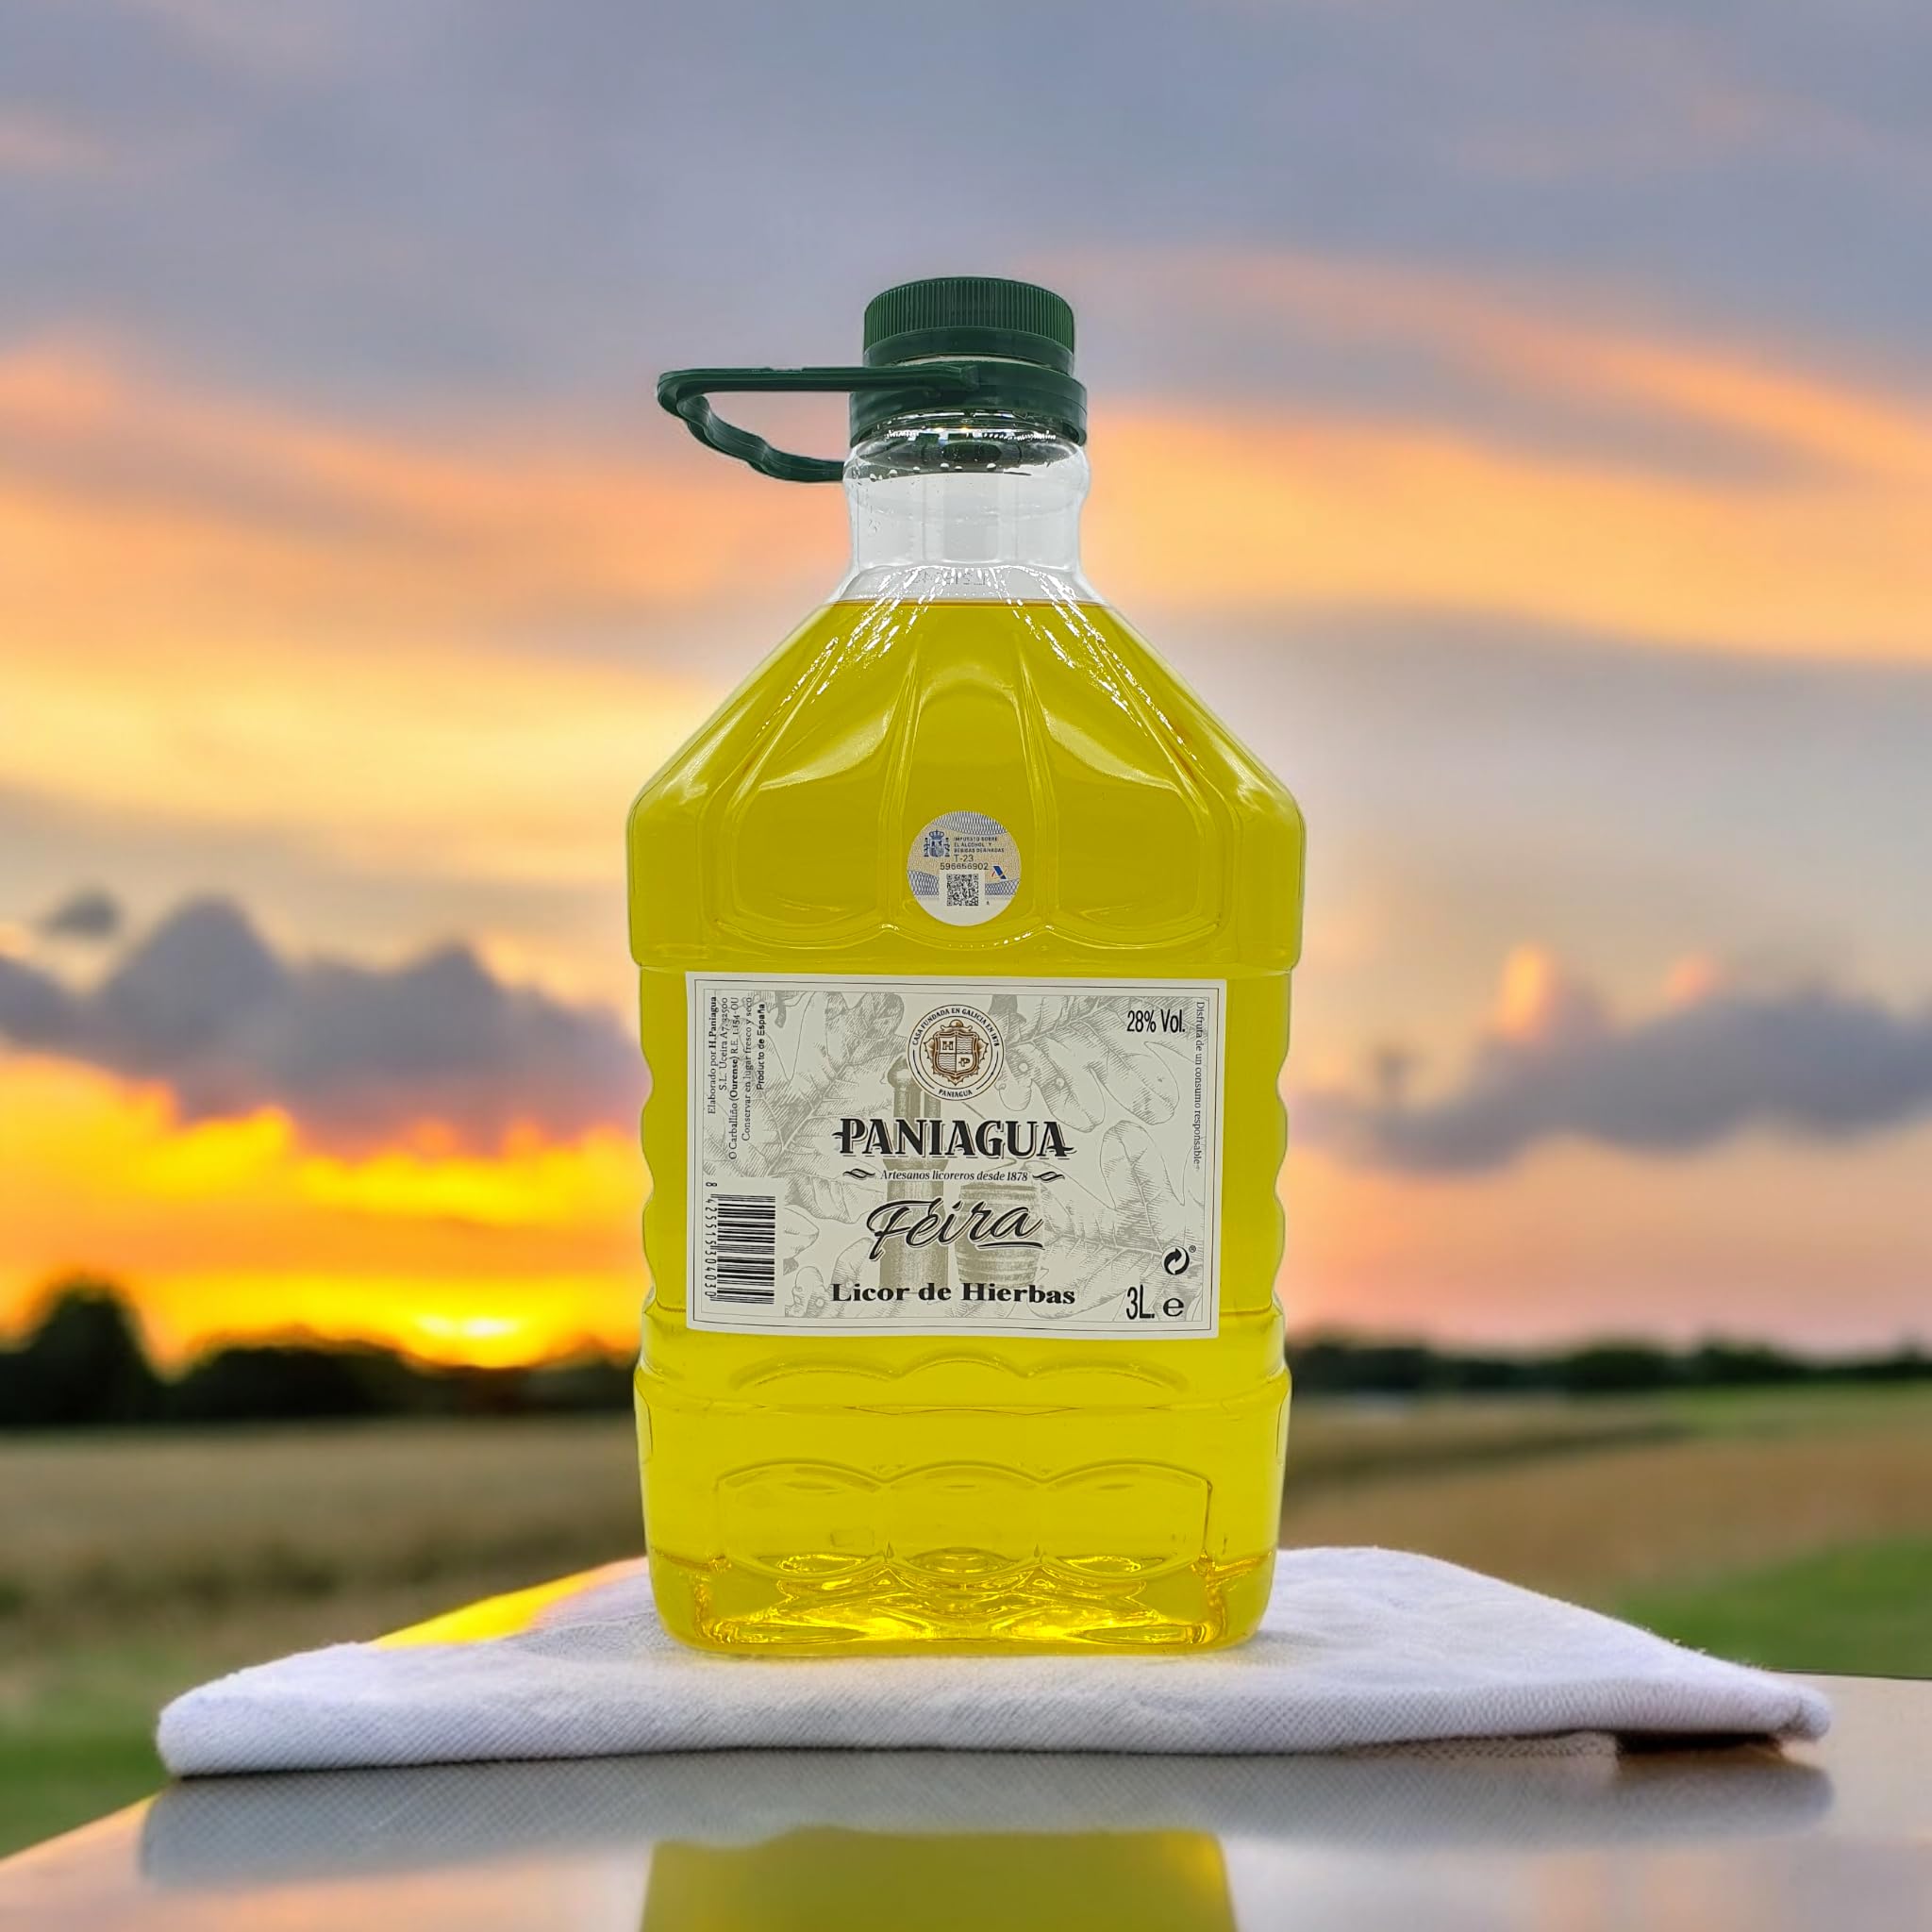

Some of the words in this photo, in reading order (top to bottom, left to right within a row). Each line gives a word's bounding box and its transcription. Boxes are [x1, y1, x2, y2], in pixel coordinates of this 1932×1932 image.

[757, 1004, 766, 1036] España
[911, 1029, 924, 1045] CASA
[920, 1008, 950, 1029] FUNDADA
[961, 1008, 987, 1024] GALICIA
[985, 1024, 995, 1033] EN
[991, 1032, 1000, 1046] 1878
[1126, 1009, 1157, 1032] 28%
[1160, 1008, 1186, 1033] Vol.
[1195, 1002, 1205, 1038] Disfruta
[719, 1041, 727, 1069] Uceira
[757, 1039, 765, 1049] de
[942, 1041, 954, 1050] H
[1195, 1040, 1204, 1051] de
[742, 1057, 754, 1078] lugar
[757, 1051, 765, 1090] Producto
[958, 1058, 971, 1067] P
[1195, 1054, 1202, 1065] un
[719, 1073, 727, 1091] S.L.
[729, 1056, 740, 1101] (Ourense)
[745, 1081, 751, 1091] en
[708, 1068, 716, 1114] Elaborado
[939, 1089, 973, 1098] PANIAGUA
[728, 1103, 738, 1149] Carballiño
[741, 1095, 751, 1141] Conservar
[832, 1118, 1077, 1160] PANIAGUA
[728, 1151, 737, 1159] O
[880, 1170, 930, 1181] Artesanos
[932, 1170, 974, 1181] licoreros
[976, 1171, 1005, 1181] desde
[1007, 1171, 1028, 1182] 1878
[831, 1283, 909, 1302] Licor
[918, 1282, 952, 1302] de
[960, 1283, 1075, 1305] Hierbas
